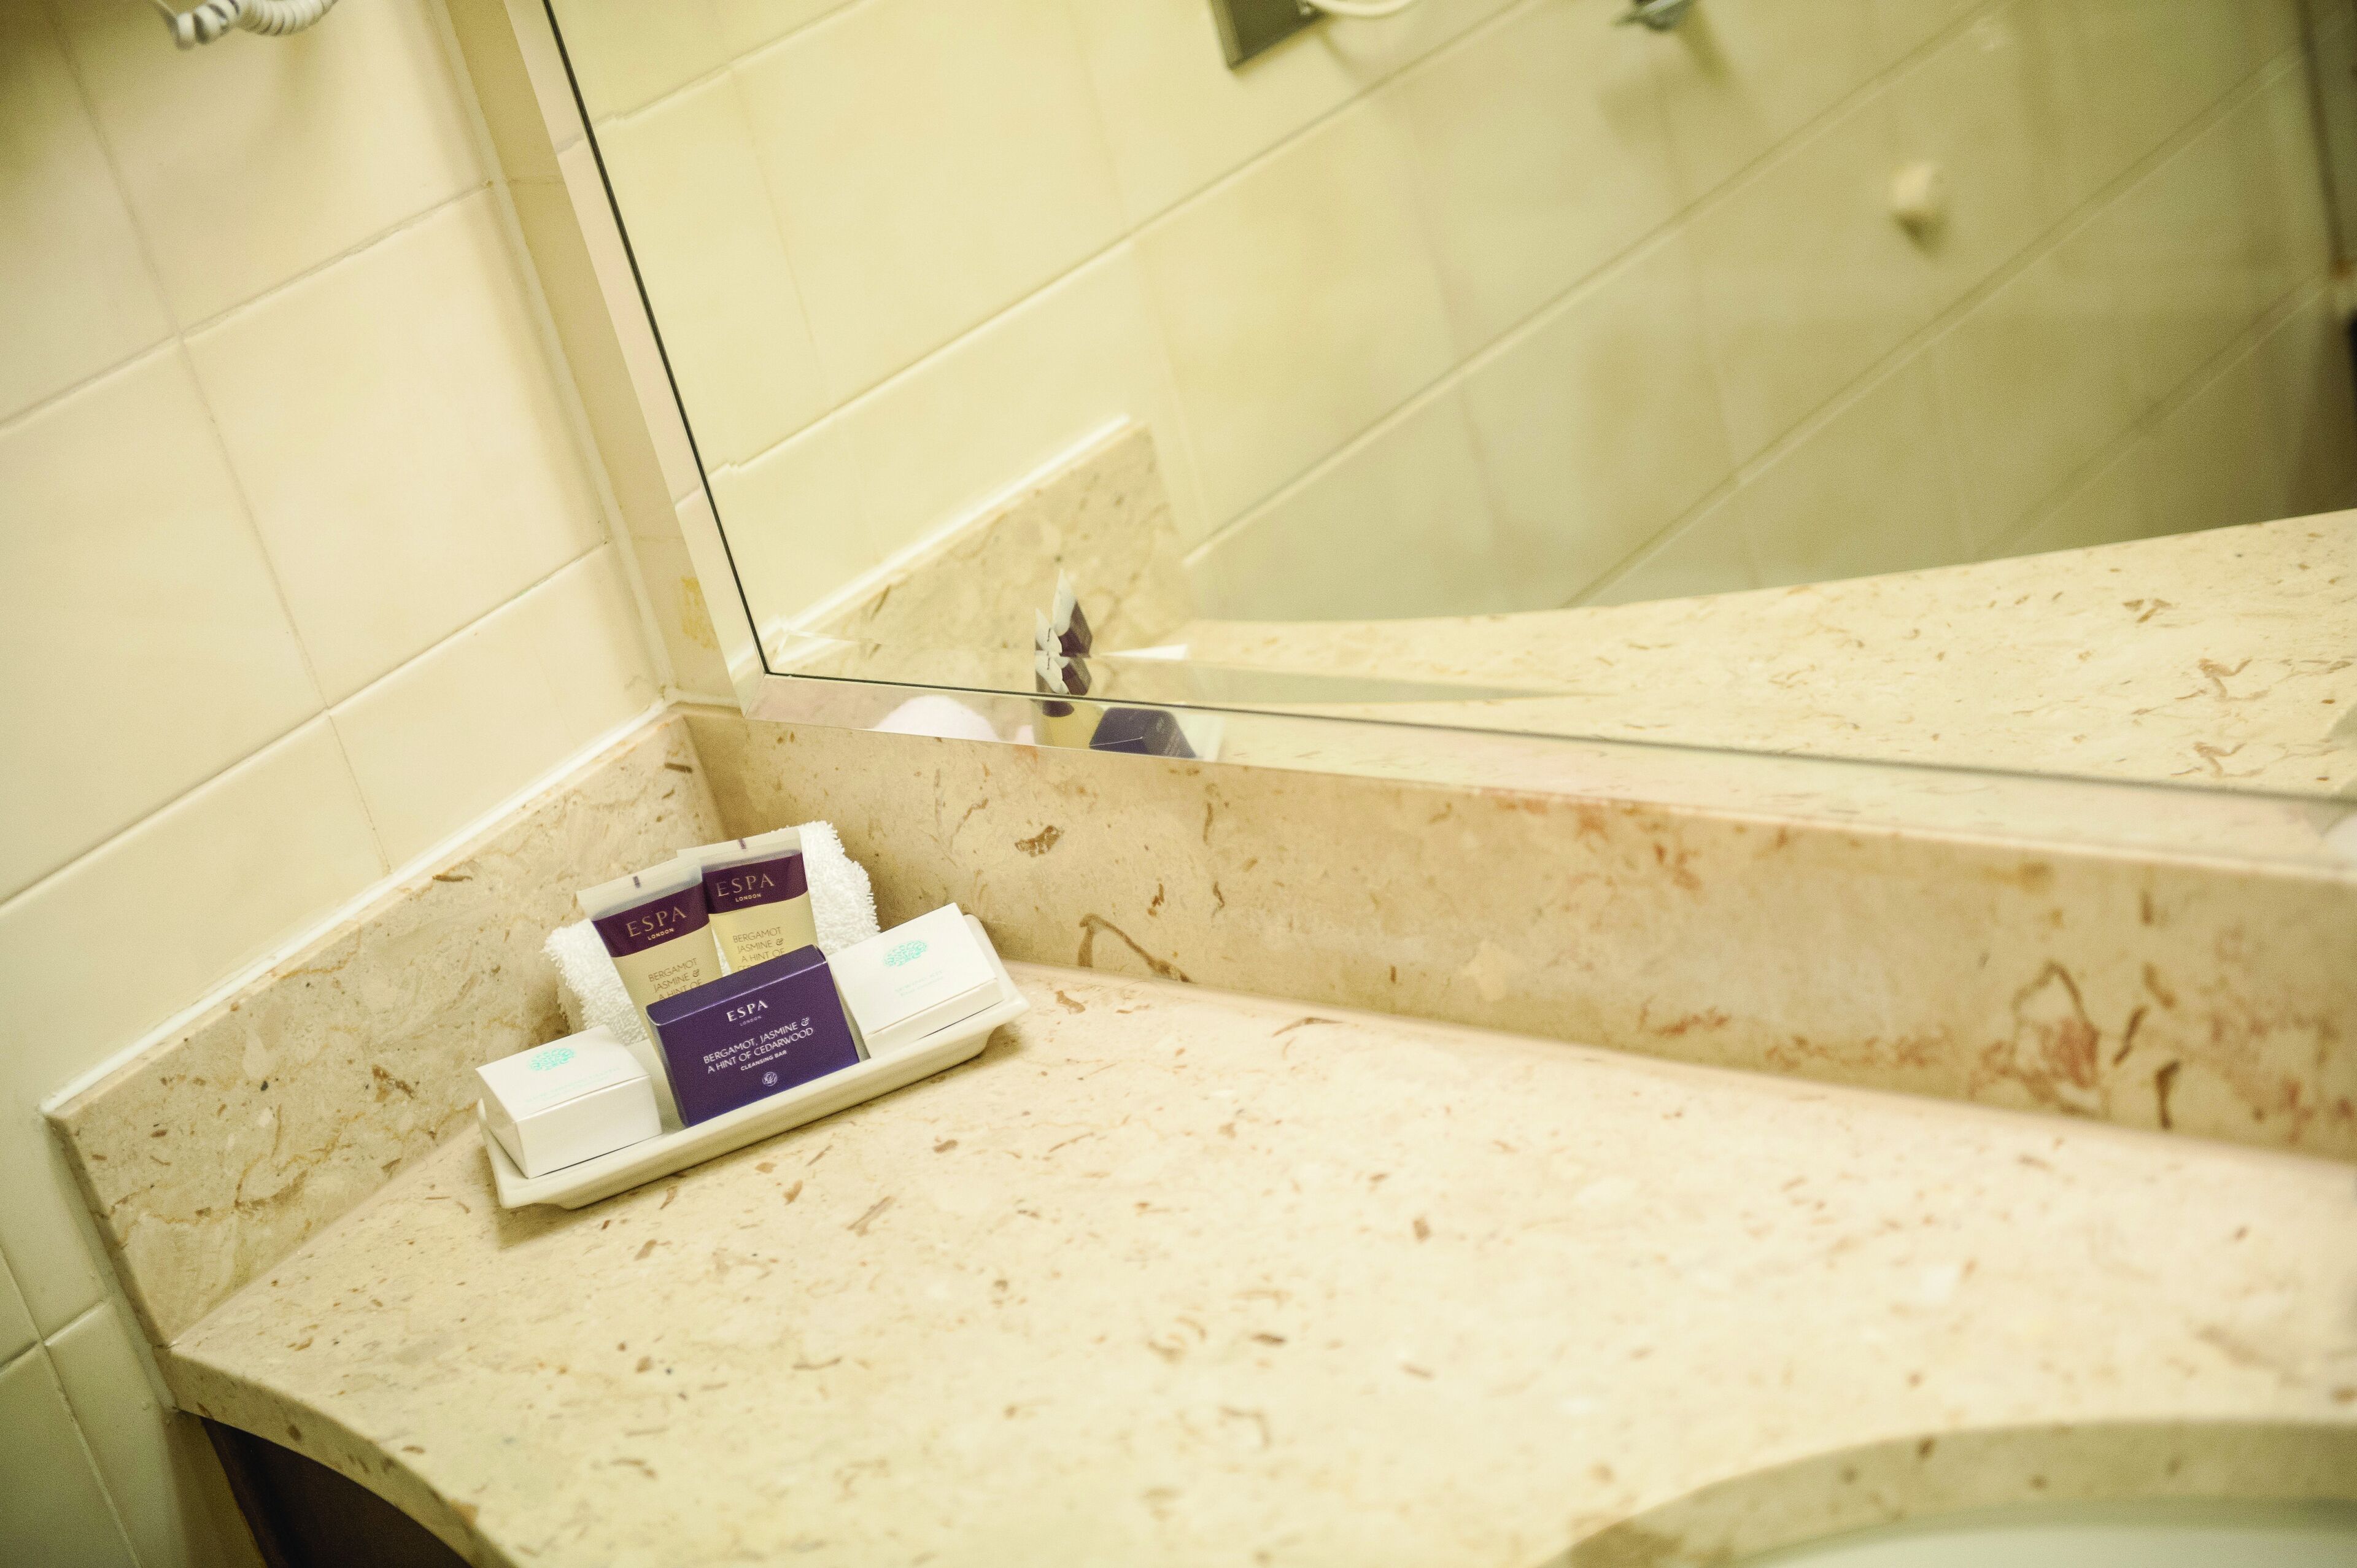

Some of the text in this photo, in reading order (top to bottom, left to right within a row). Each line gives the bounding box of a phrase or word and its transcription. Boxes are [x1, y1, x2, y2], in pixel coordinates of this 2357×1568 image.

[716, 873, 775, 897] ESPA
[735, 893, 761, 902] LONDON
[626, 906, 687, 937] ESPA
[647, 928, 675, 940] LONDON
[732, 927, 781, 943] BERGAMOT
[737, 940, 773, 954] JASMINE
[749, 951, 770, 961] HINT
[772, 948, 785, 957] OF
[648, 957, 697, 983] BERGAMOT
[654, 969, 700, 992] JASMINE &
[690, 979, 702, 989] OF
[726, 1000, 768, 1022] ESPA
[740, 1016, 762, 1026] LONDON
[703, 1016, 810, 1064] BERGAMOT, JASMINE &
[708, 1027, 813, 1074] A HINT OF CEDARWOOD
[740, 1050, 788, 1071] CLEANSING BAR
